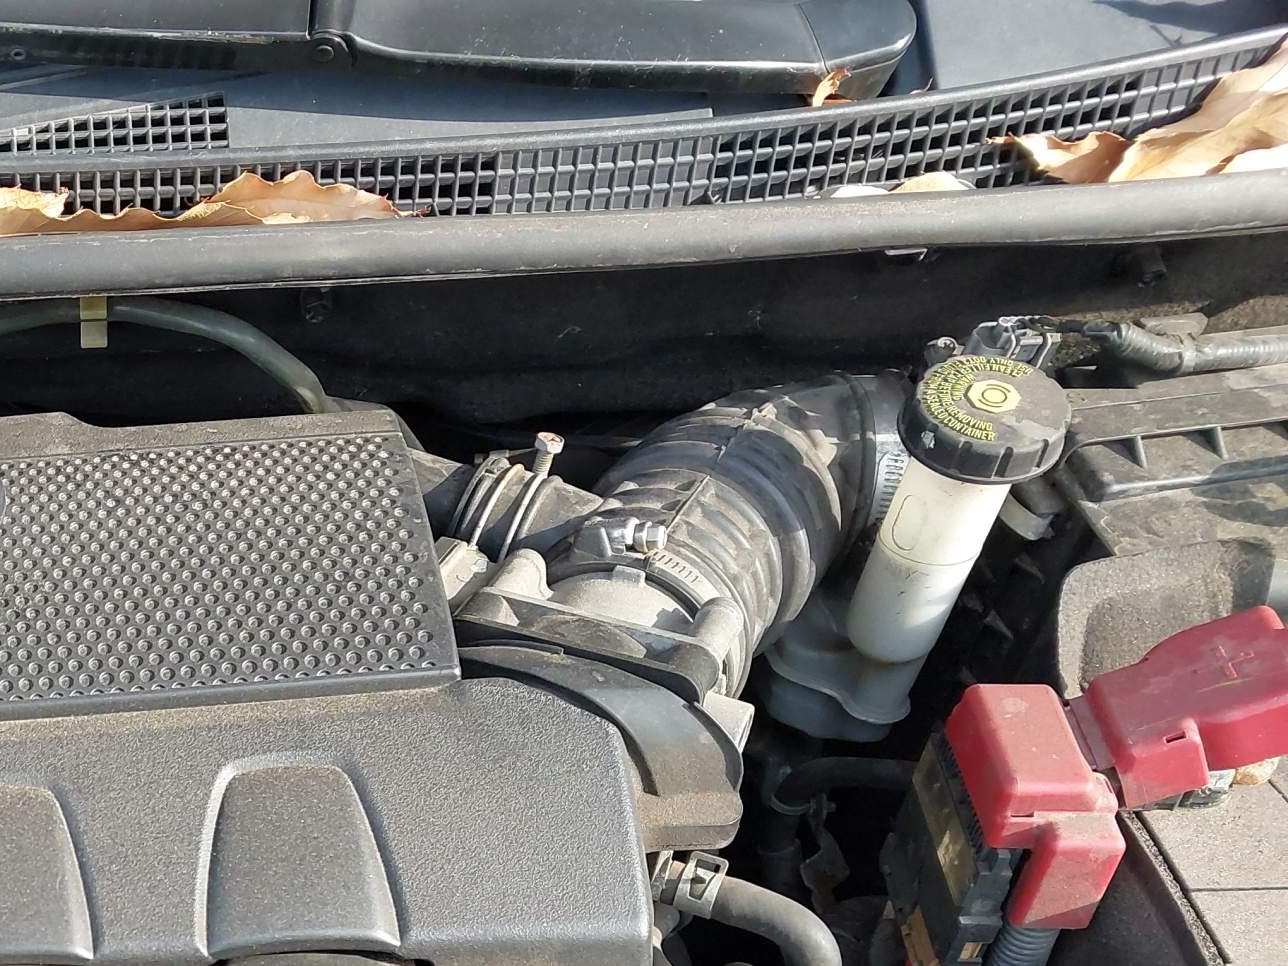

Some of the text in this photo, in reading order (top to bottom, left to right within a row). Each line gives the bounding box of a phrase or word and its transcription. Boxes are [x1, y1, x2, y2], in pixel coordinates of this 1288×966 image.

[961, 364, 990, 375] FILLER
[990, 357, 1015, 367] ONLY
[938, 382, 954, 406] BEFORE
[927, 395, 949, 419] SEALED
[946, 403, 993, 430] REMOVING
[943, 416, 996, 441] CONTAINER
